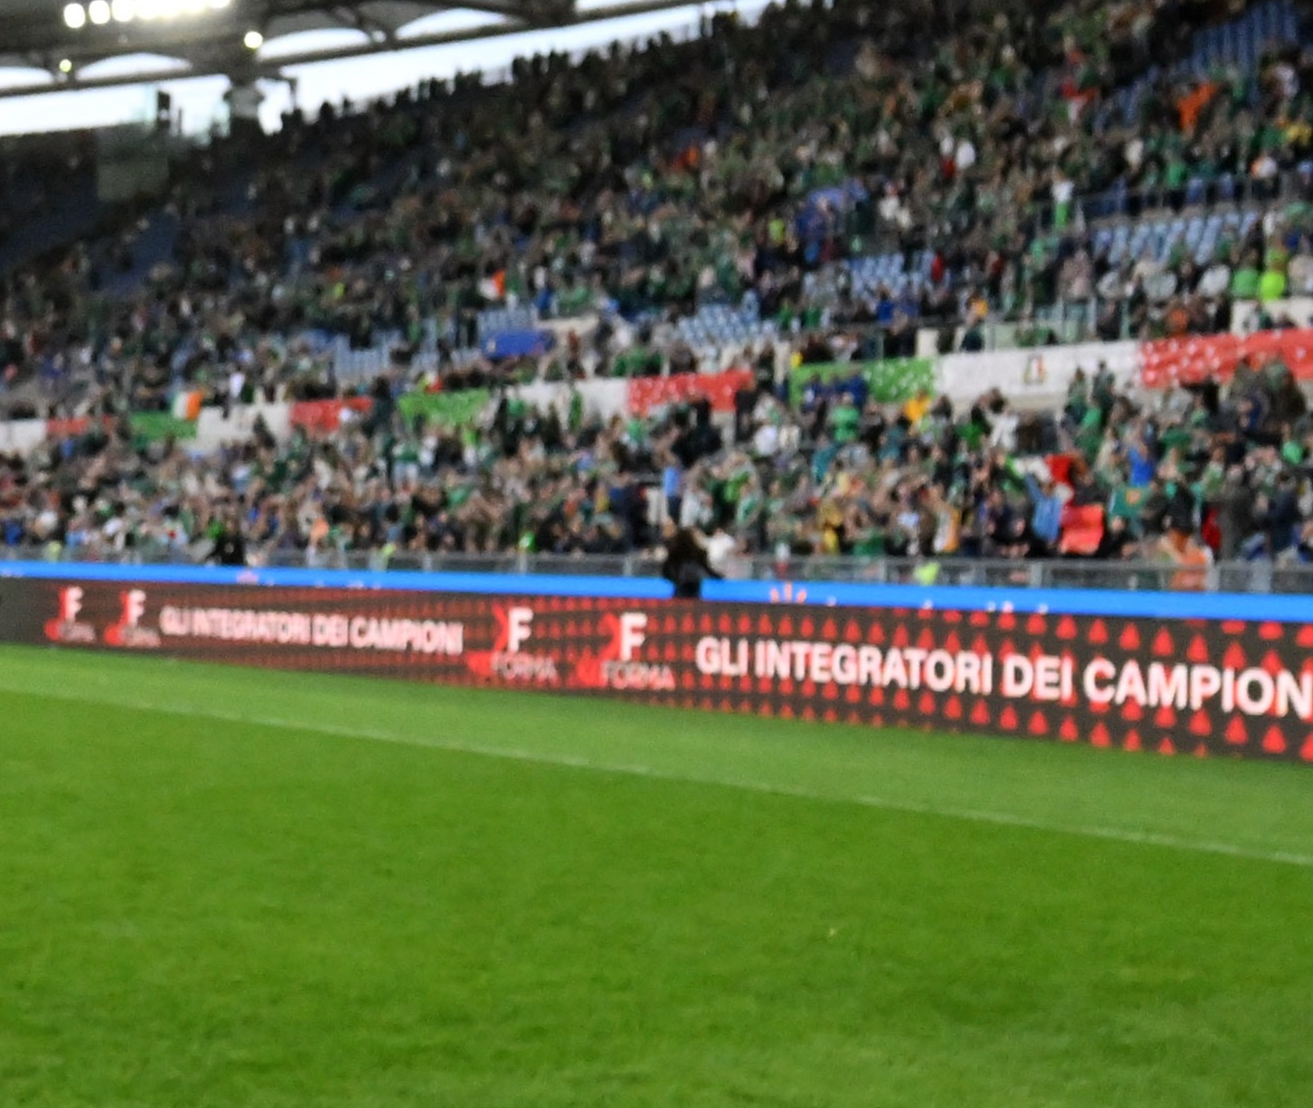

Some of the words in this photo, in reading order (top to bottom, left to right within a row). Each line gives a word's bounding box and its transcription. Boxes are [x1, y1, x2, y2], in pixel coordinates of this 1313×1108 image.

[160, 606, 191, 636] GLI
[192, 607, 309, 644] INTEGRATORI
[310, 613, 348, 647] DEI
[349, 616, 464, 656] CAMPIONI
[695, 635, 749, 676] GLI
[755, 638, 993, 696] INTEGRATORI
[1002, 654, 1073, 701] DEI
[1083, 658, 1313, 721] CAMPION
